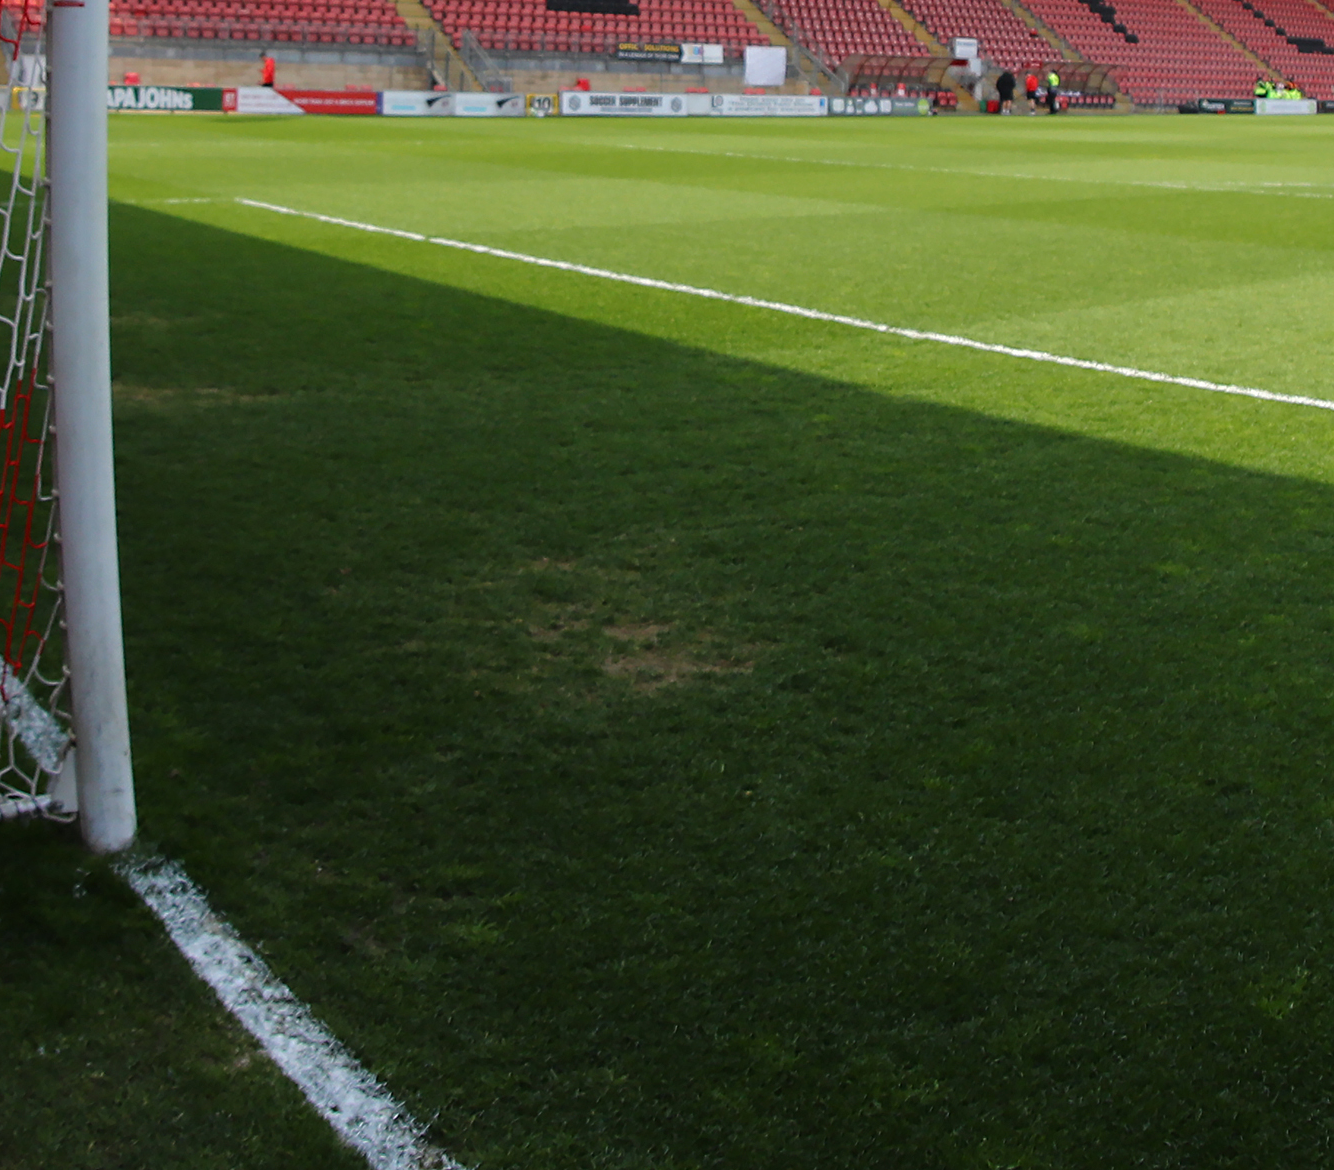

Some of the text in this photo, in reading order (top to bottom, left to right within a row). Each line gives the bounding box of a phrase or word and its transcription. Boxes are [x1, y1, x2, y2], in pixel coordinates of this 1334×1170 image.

[644, 44, 680, 52] SOLUTIONS
[108, 87, 193, 109] APAJOHNS
[589, 95, 663, 108] SOCCER SUPPLEMENT
